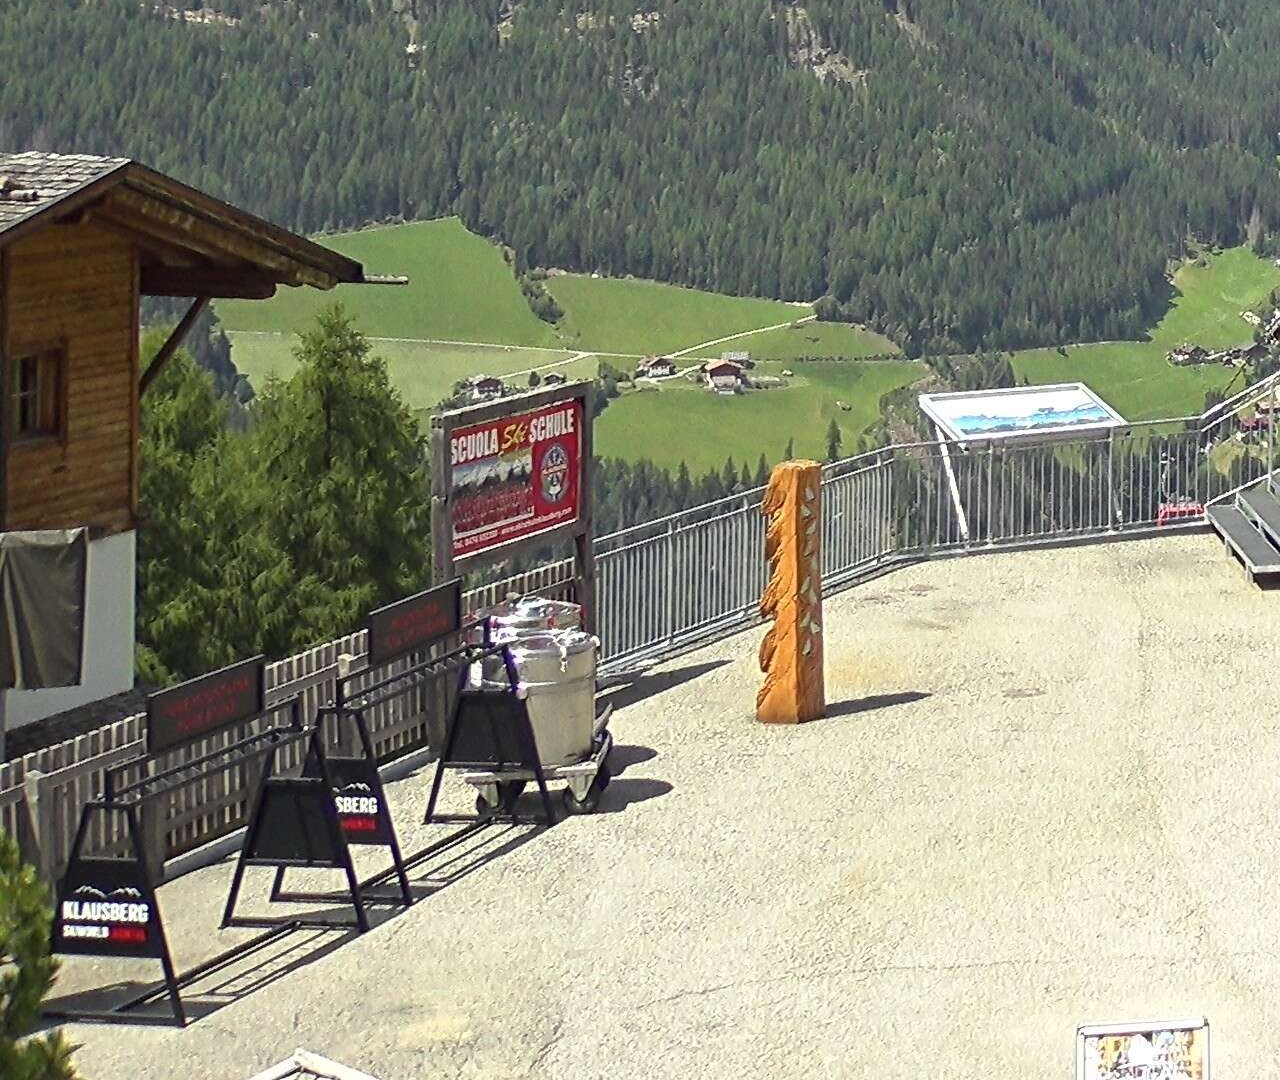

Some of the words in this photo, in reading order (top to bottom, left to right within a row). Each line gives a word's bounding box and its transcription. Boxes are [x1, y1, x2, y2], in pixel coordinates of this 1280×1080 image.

[451, 428, 499, 465] SCUOLA
[529, 408, 574, 443] SCHULE
[62, 900, 149, 924] KLAUSBERG
